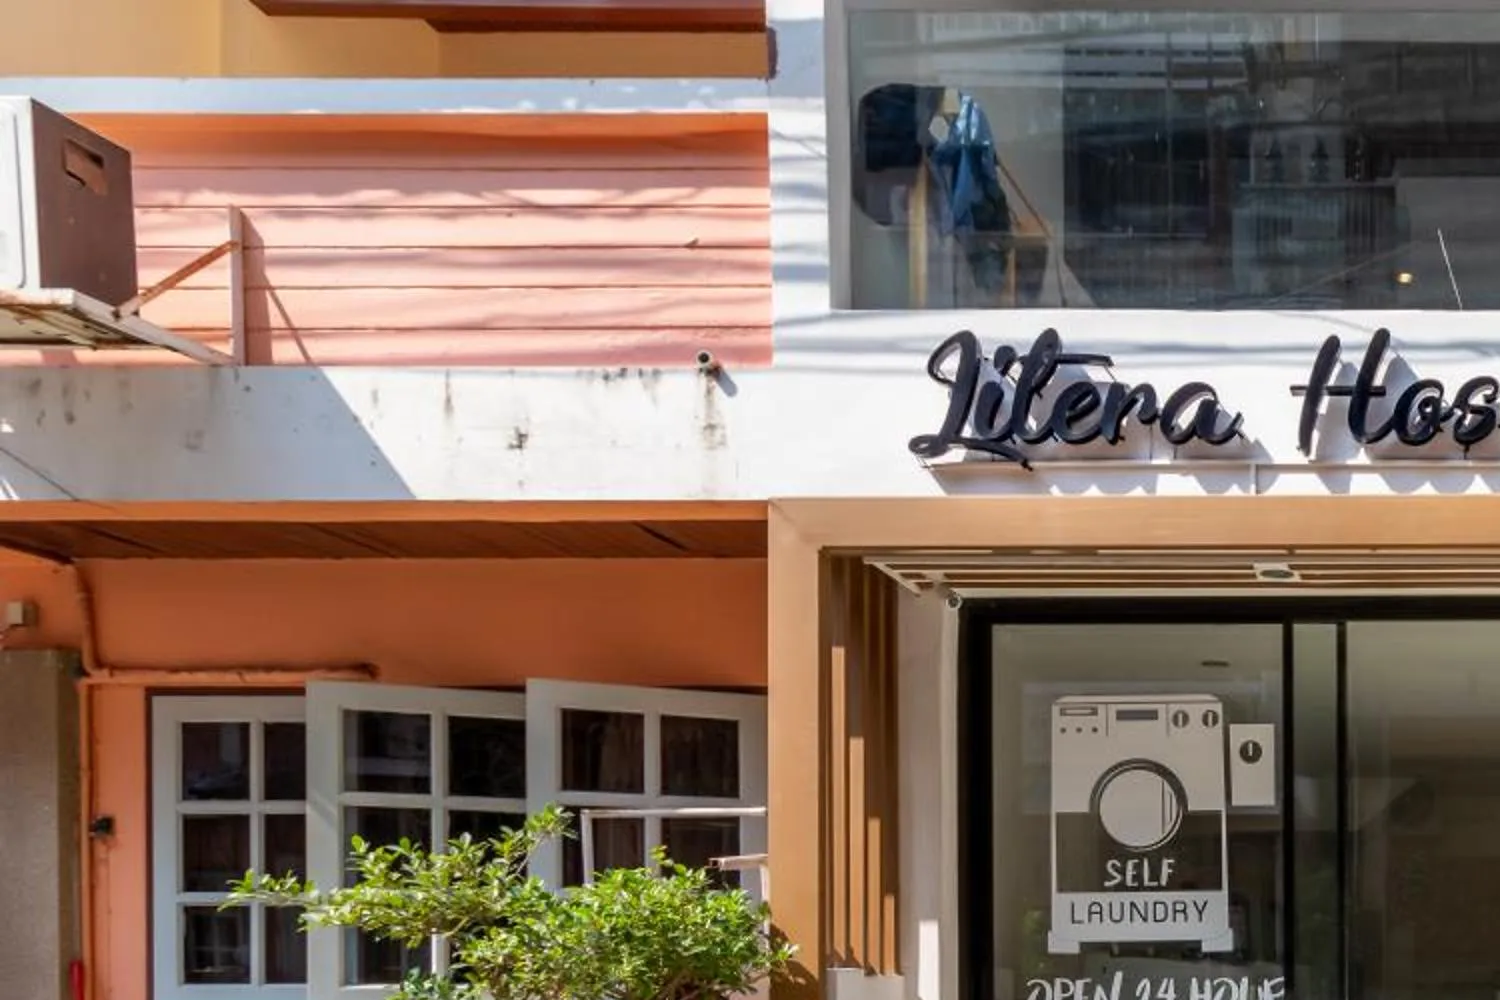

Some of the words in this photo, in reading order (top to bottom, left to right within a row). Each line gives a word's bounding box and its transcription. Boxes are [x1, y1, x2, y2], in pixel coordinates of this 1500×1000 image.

[908, 327, 1243, 472] Litera
[1104, 858, 1176, 887] SELF
[1071, 900, 1210, 925] LAUNDRY
